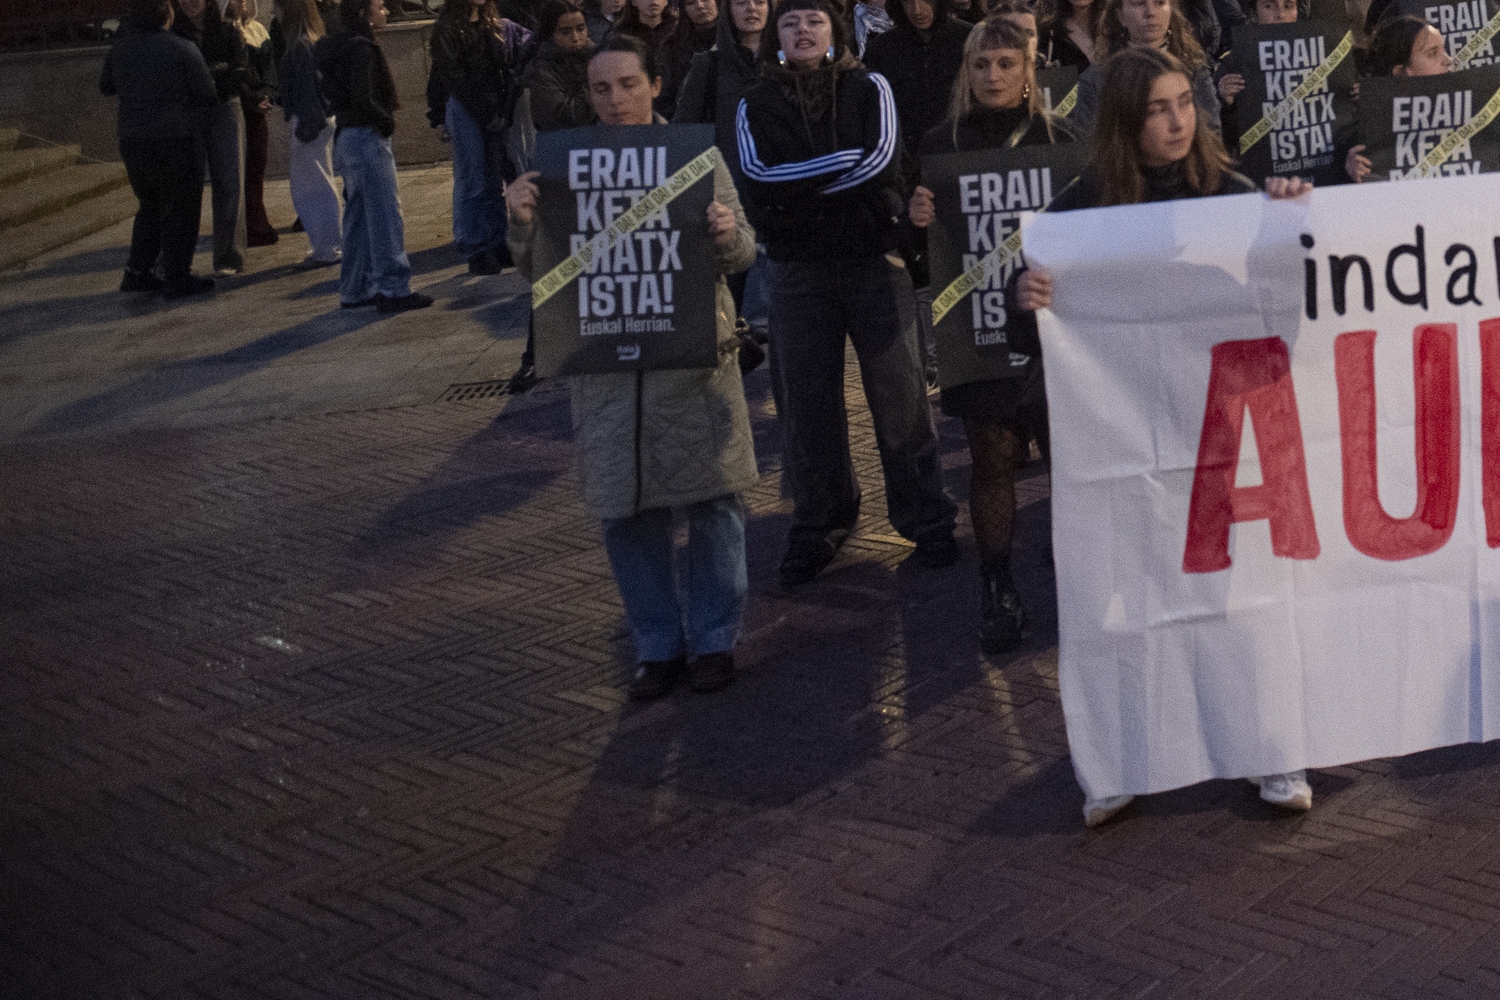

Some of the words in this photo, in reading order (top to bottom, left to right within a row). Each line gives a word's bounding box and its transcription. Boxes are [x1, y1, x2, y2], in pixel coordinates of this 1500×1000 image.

[1269, 122, 1335, 162] ISTA!
[578, 273, 675, 318] ISTA!
[580, 318, 622, 336] Euskal
